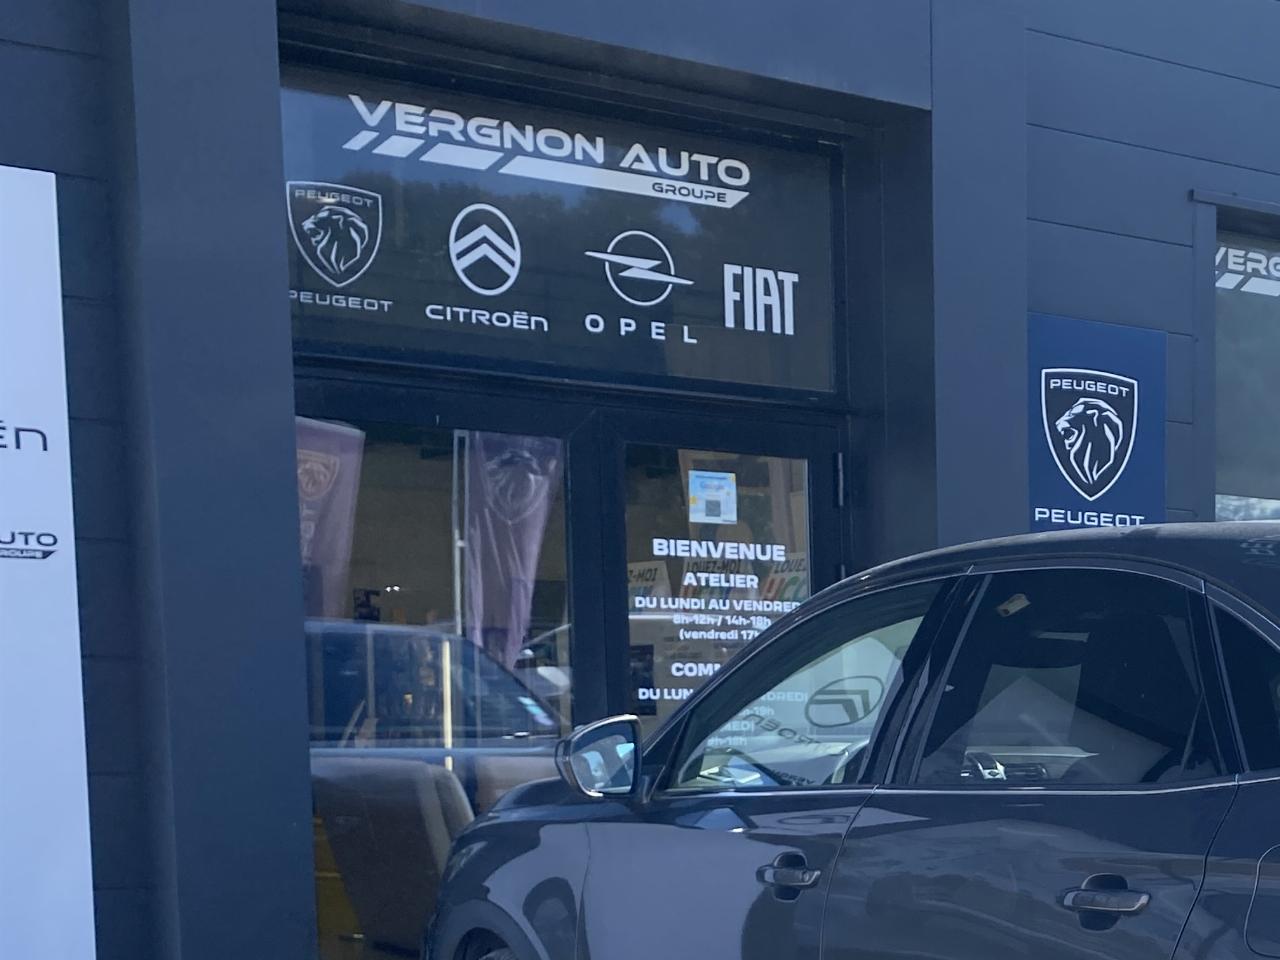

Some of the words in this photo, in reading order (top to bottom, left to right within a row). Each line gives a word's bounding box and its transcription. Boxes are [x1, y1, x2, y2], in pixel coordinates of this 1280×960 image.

[348, 94, 605, 165] VERGNON
[618, 142, 751, 187] AUTO
[295, 189, 373, 207] PEUGEOT
[651, 181, 728, 203] GROUPE
[723, 263, 799, 336] FIAT
[584, 313, 699, 345] OPEL
[1049, 377, 1130, 397] PEUGEOT
[1034, 507, 1145, 527] PEUGEOT
[0, 531, 58, 546] UTO
[652, 538, 786, 562] BIENVENUE
[683, 572, 759, 589] ATELIER
[634, 596, 657, 608] DU
[659, 597, 706, 610] LUNDI
[708, 598, 730, 611] AU
[638, 687, 660, 700] DU
